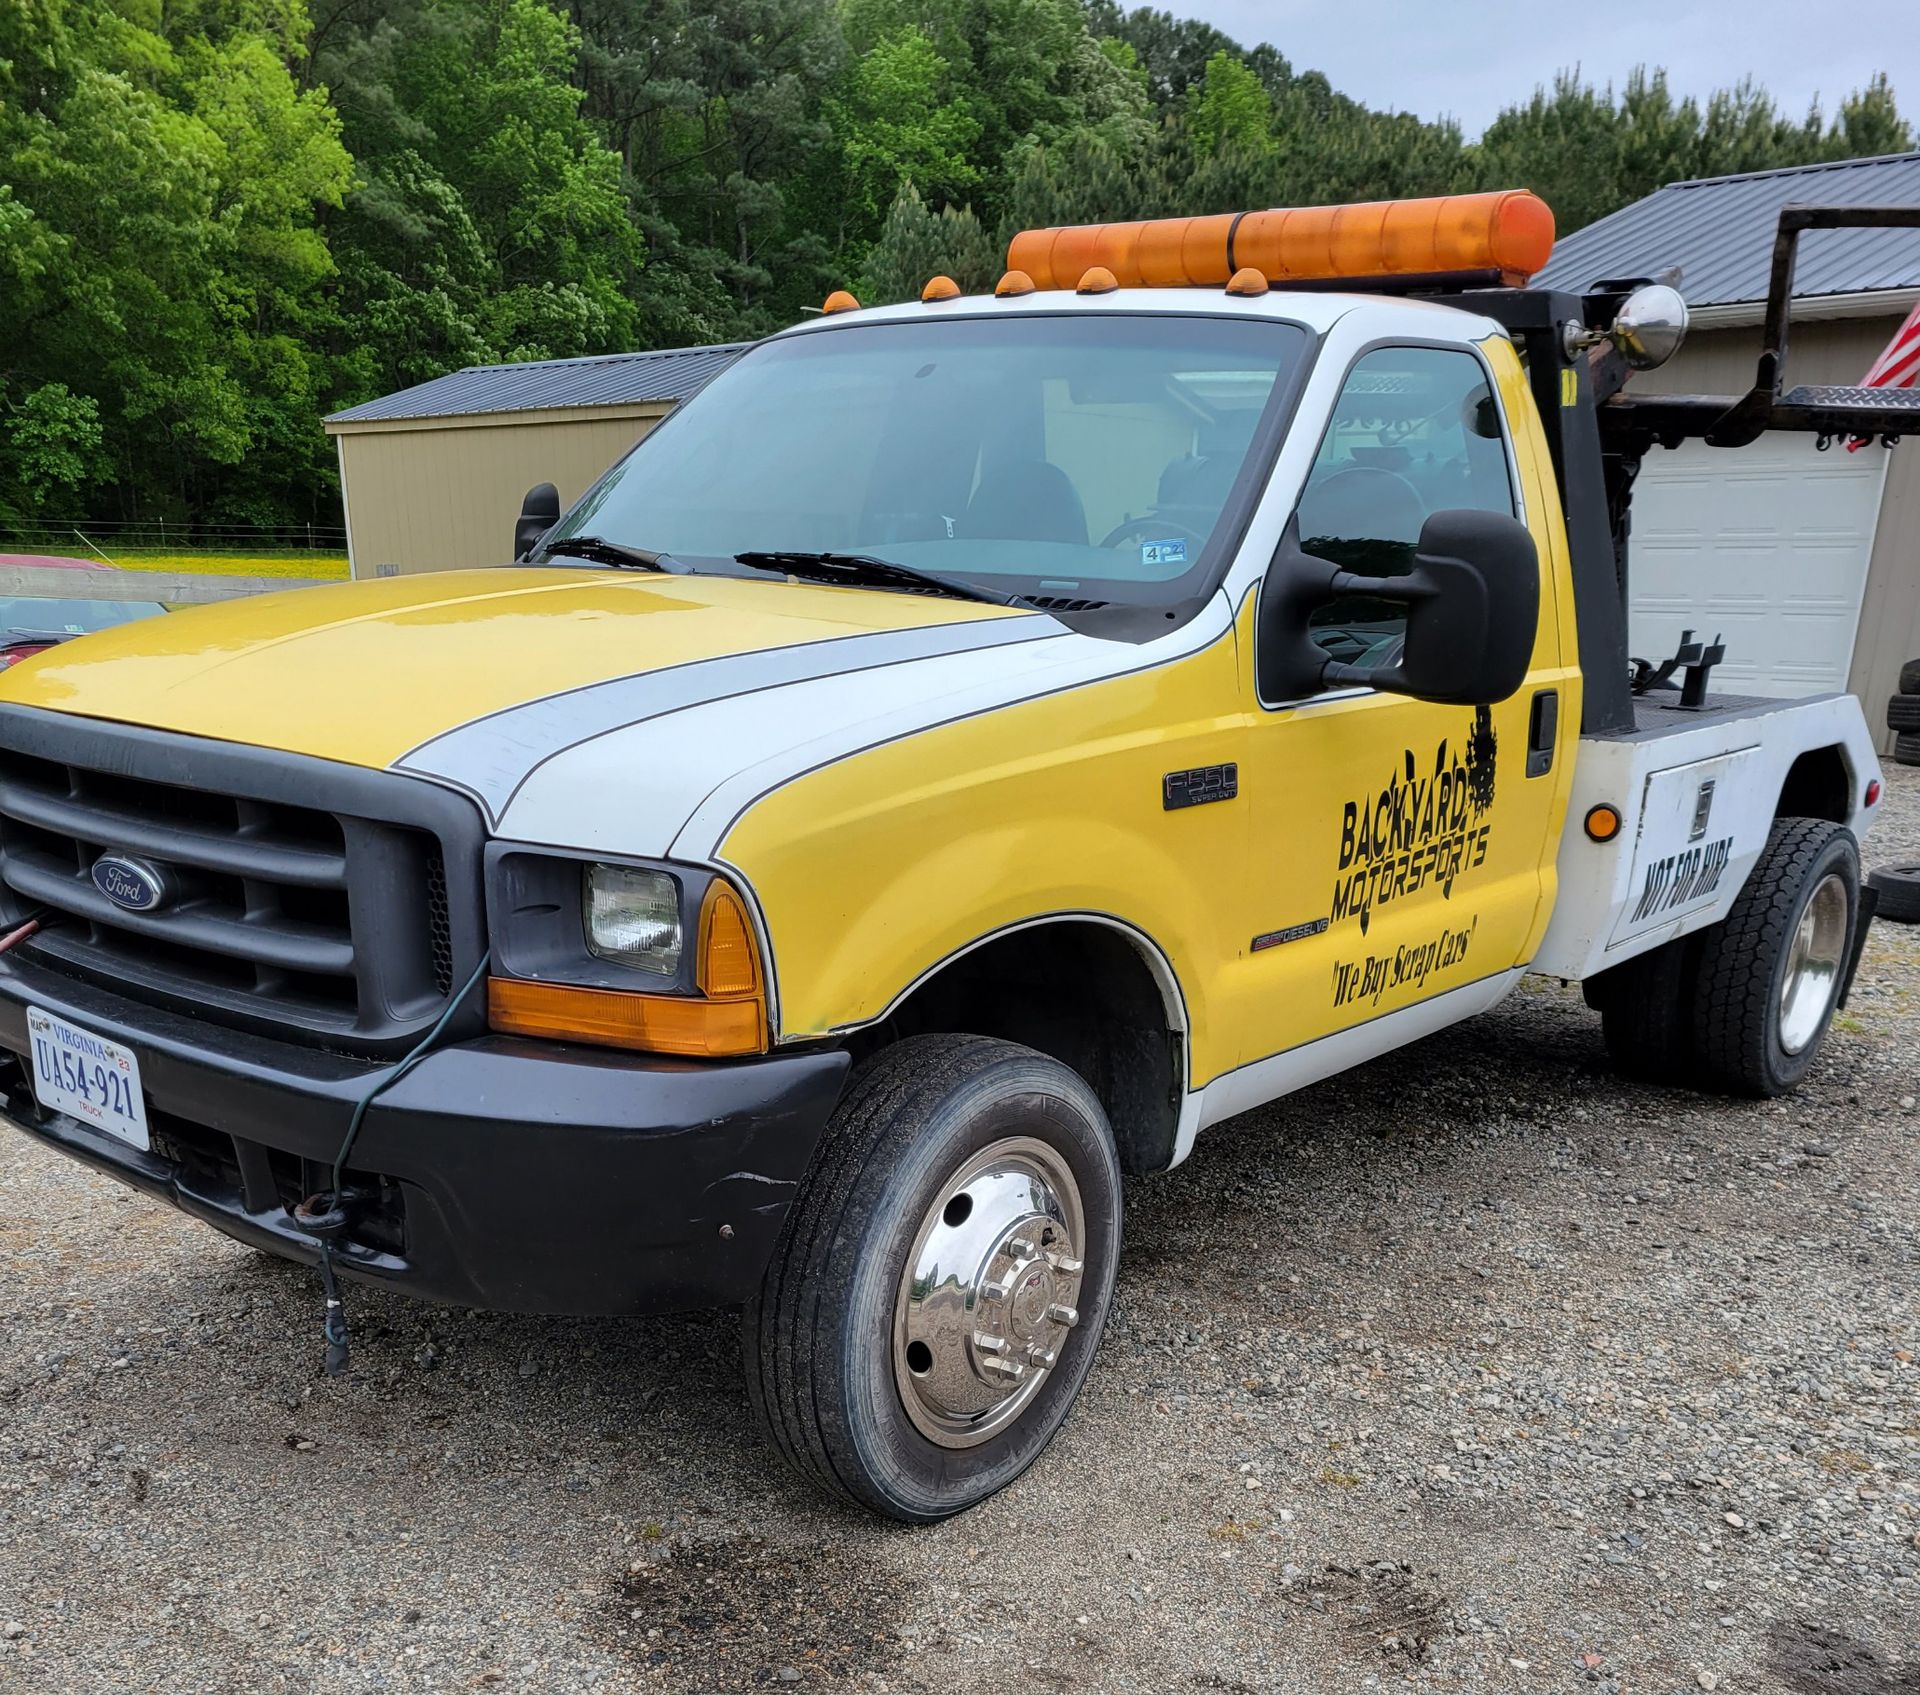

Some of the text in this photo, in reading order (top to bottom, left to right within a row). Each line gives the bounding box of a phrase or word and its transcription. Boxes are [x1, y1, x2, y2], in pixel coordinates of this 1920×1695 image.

[1147, 547, 1158, 560] 4
[1338, 766, 1468, 871] BACKYARD
[106, 867, 141, 901] Ford
[1330, 824, 1491, 924] MOTORSPORTS
[1630, 836, 1733, 924] NOT FOR HIRE
[1282, 924, 1316, 942] DIESEL
[1358, 955, 1393, 1007] Buy
[1389, 945, 1437, 988] Scrap
[53, 1023, 107, 1062] VIRGINIA
[36, 1038, 137, 1122] UA54-921
[118, 1058, 130, 1072] 23
[79, 1100, 104, 1119] TRUCK
